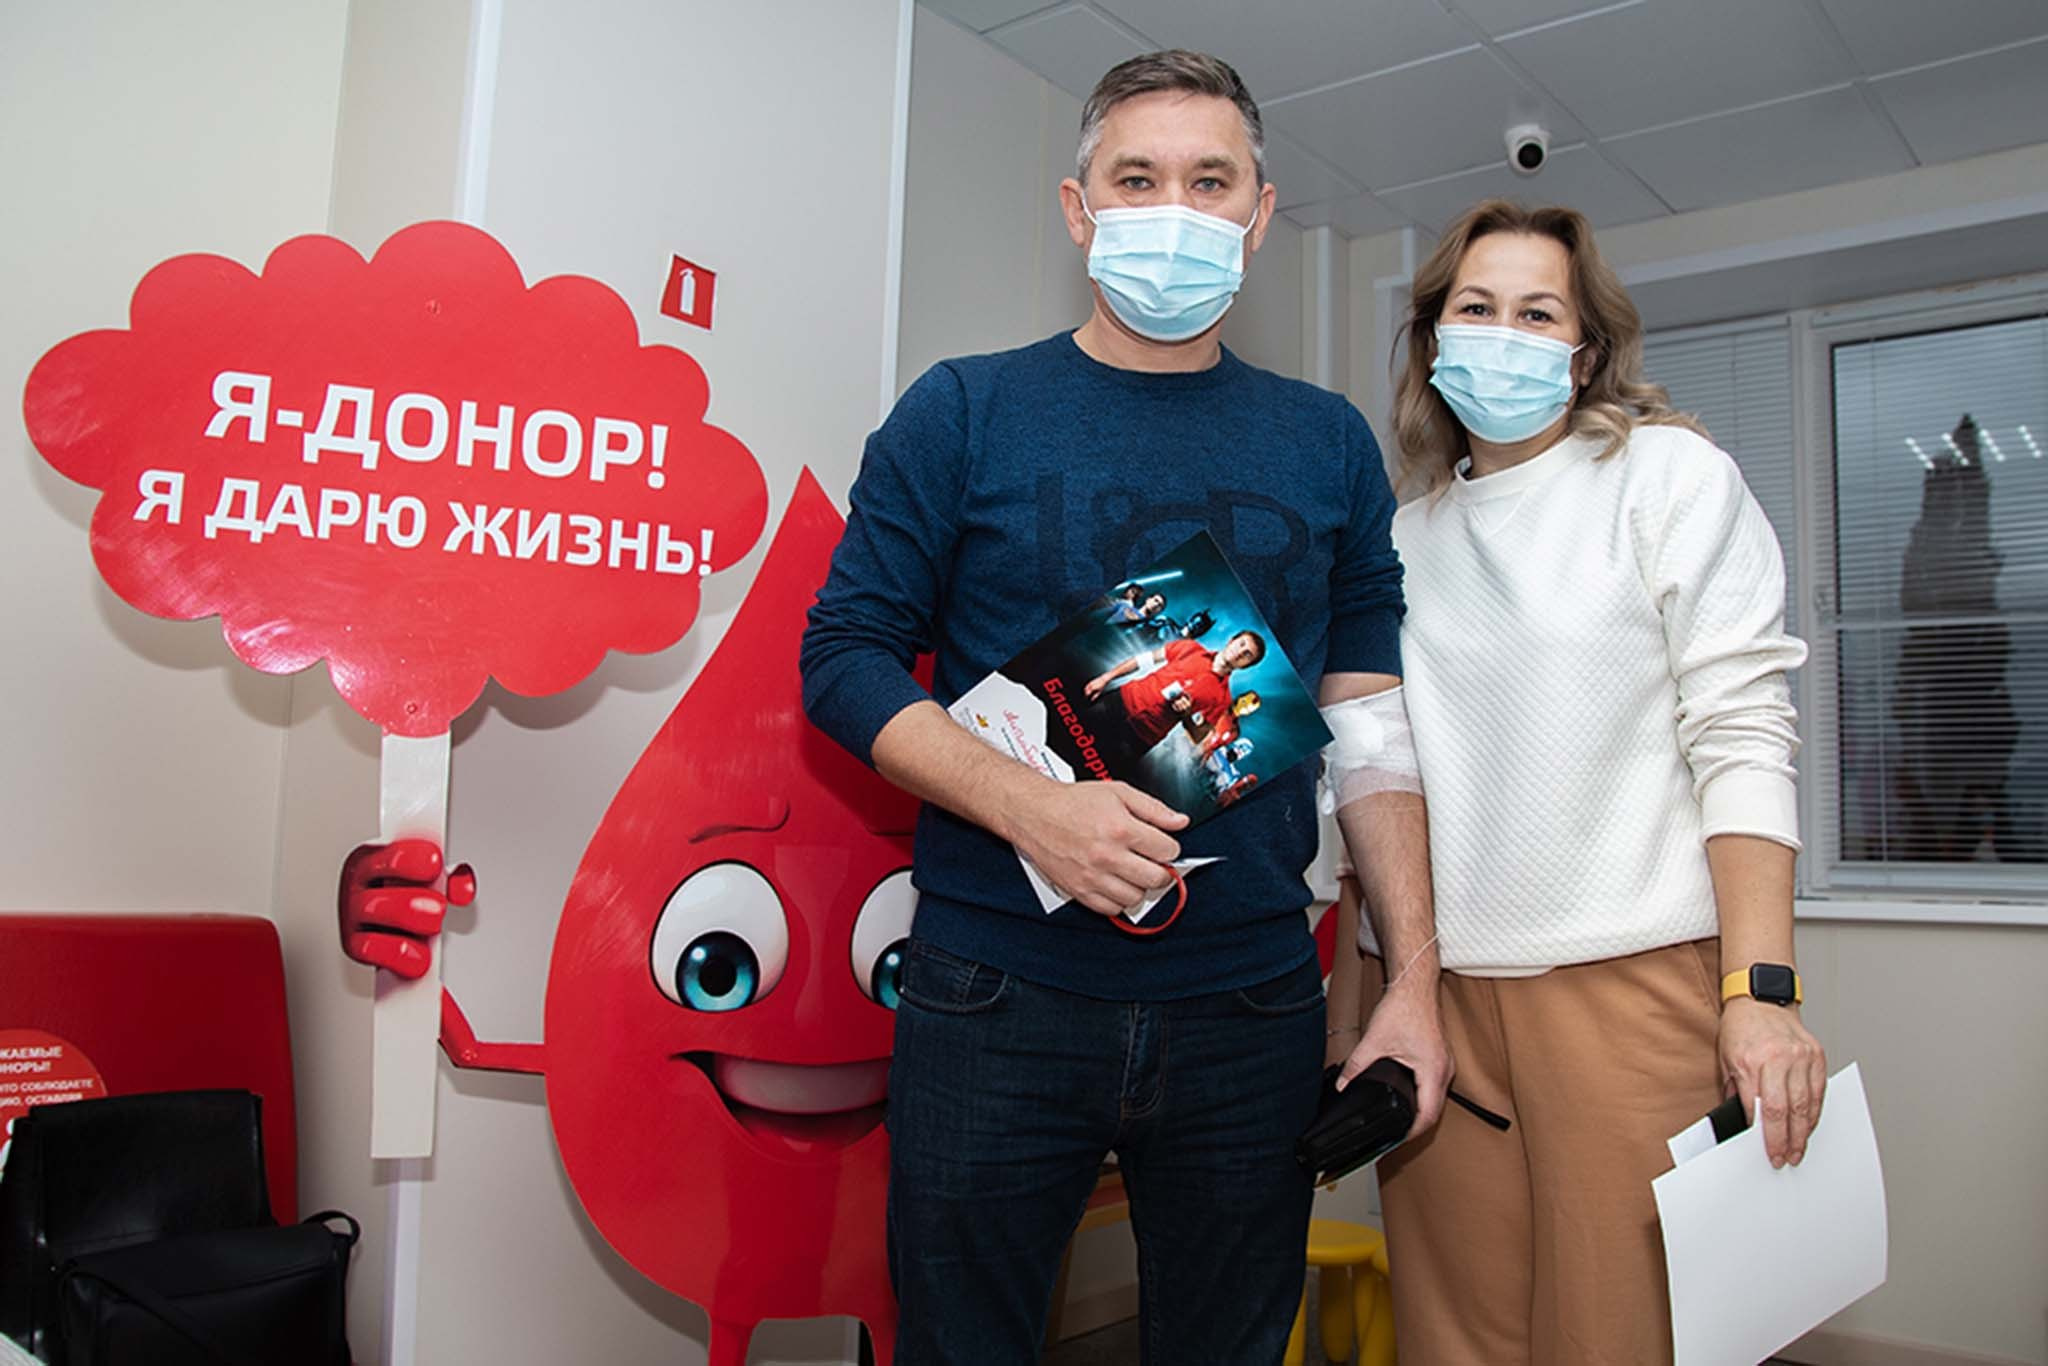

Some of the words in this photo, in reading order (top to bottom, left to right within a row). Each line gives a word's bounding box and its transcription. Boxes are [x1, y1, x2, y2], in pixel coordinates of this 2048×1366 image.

[204, 370, 669, 489] Я-ДОНОР!
[133, 469, 186, 524] Я
[204, 477, 428, 549] ДАРЮ
[443, 501, 715, 577] ЖИЗНЬ!
